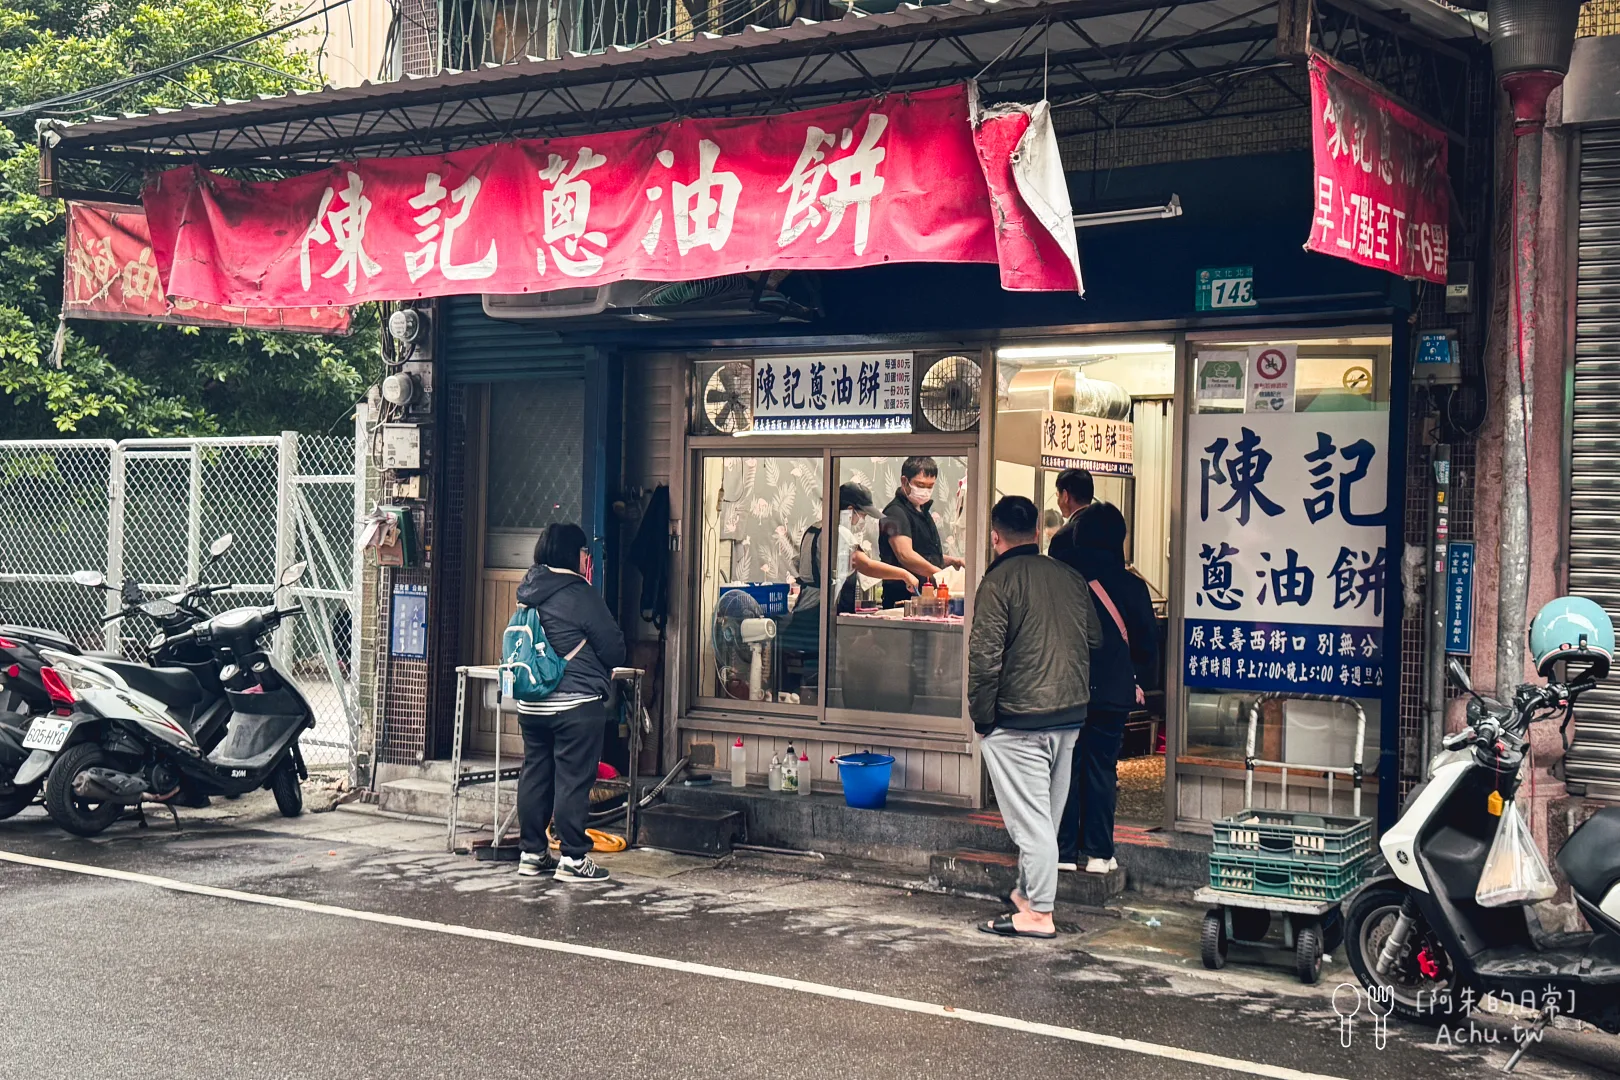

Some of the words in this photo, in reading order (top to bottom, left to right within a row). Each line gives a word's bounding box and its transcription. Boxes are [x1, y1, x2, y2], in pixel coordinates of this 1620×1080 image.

[299, 113, 888, 294] 陳記蔥油餅
[1216, 280, 1253, 304] 143
[756, 361, 880, 410] 陳記蔥油餅
[1043, 415, 1118, 458] 陳記蔥油餅
[1200, 426, 1388, 527] 陳記
[1195, 542, 1385, 617] 蔥油餅
[1189, 625, 1306, 654] 原長壽西街口
[1316, 632, 1384, 658] 別無分
[1188, 654, 1231, 679] 營業時間
[231, 769, 247, 778] SYM
